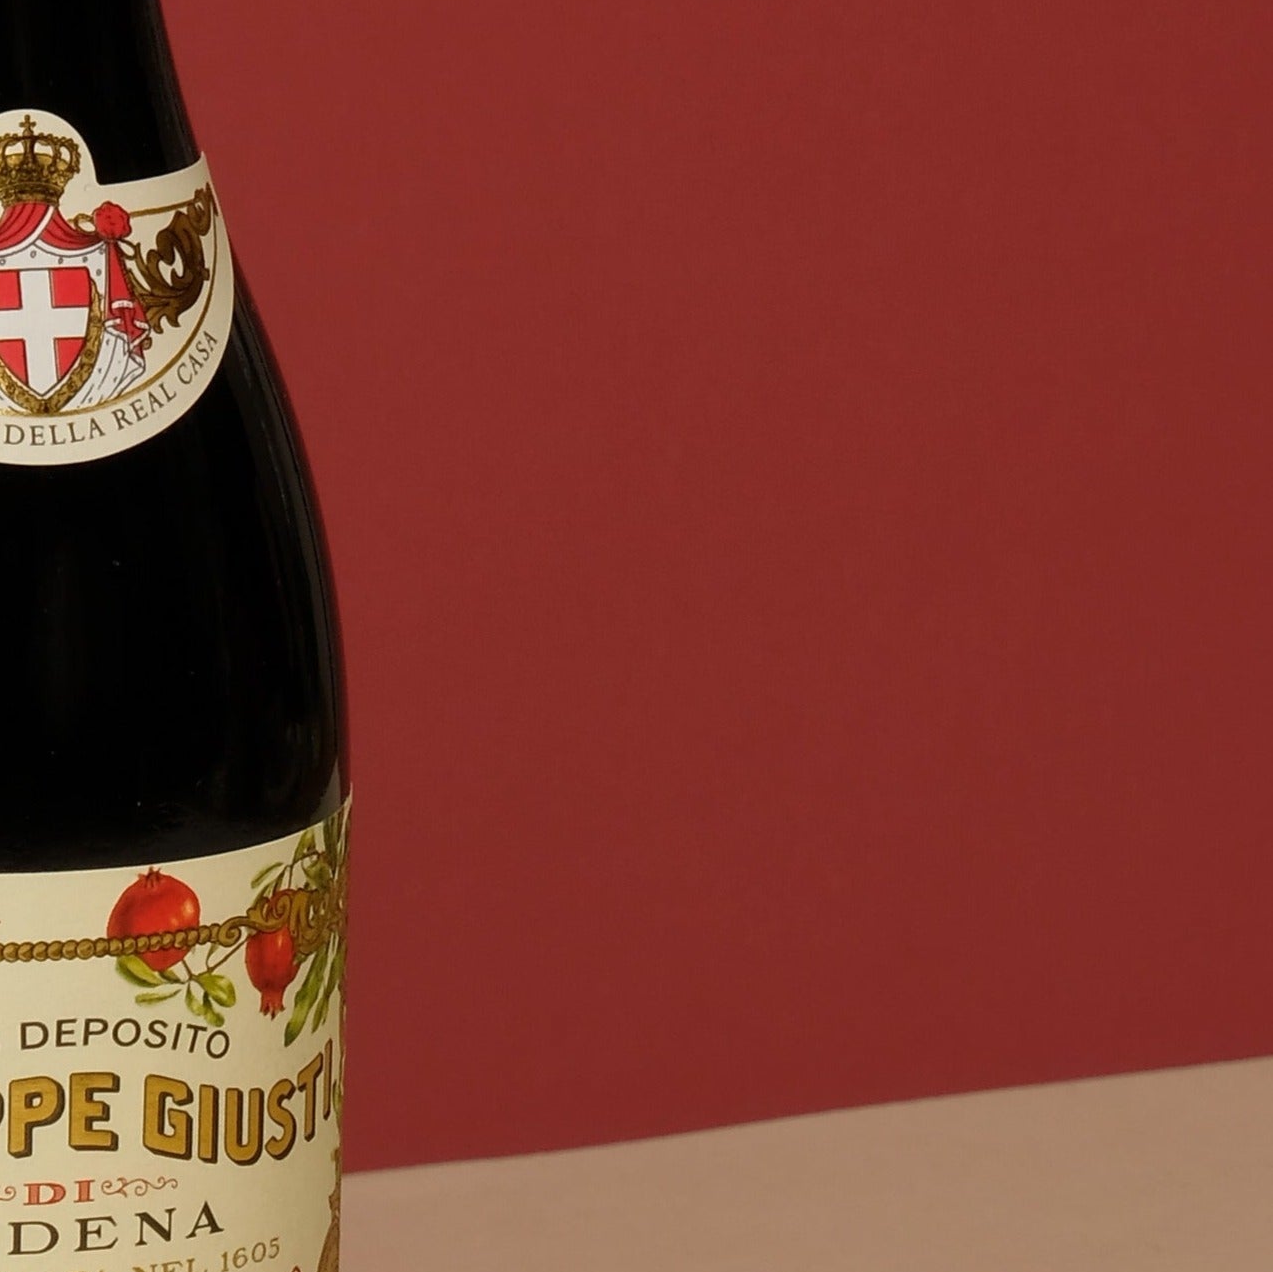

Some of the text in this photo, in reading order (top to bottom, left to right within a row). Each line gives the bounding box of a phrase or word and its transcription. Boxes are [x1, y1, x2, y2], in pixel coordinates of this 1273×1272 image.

[3, 418, 106, 447] DELLA
[111, 391, 177, 431] REAL
[176, 329, 219, 386] CASA
[21, 1018, 231, 1059] DEPOSITO
[142, 1040, 334, 1166] GIUSTI
[23, 1179, 94, 1206] DI
